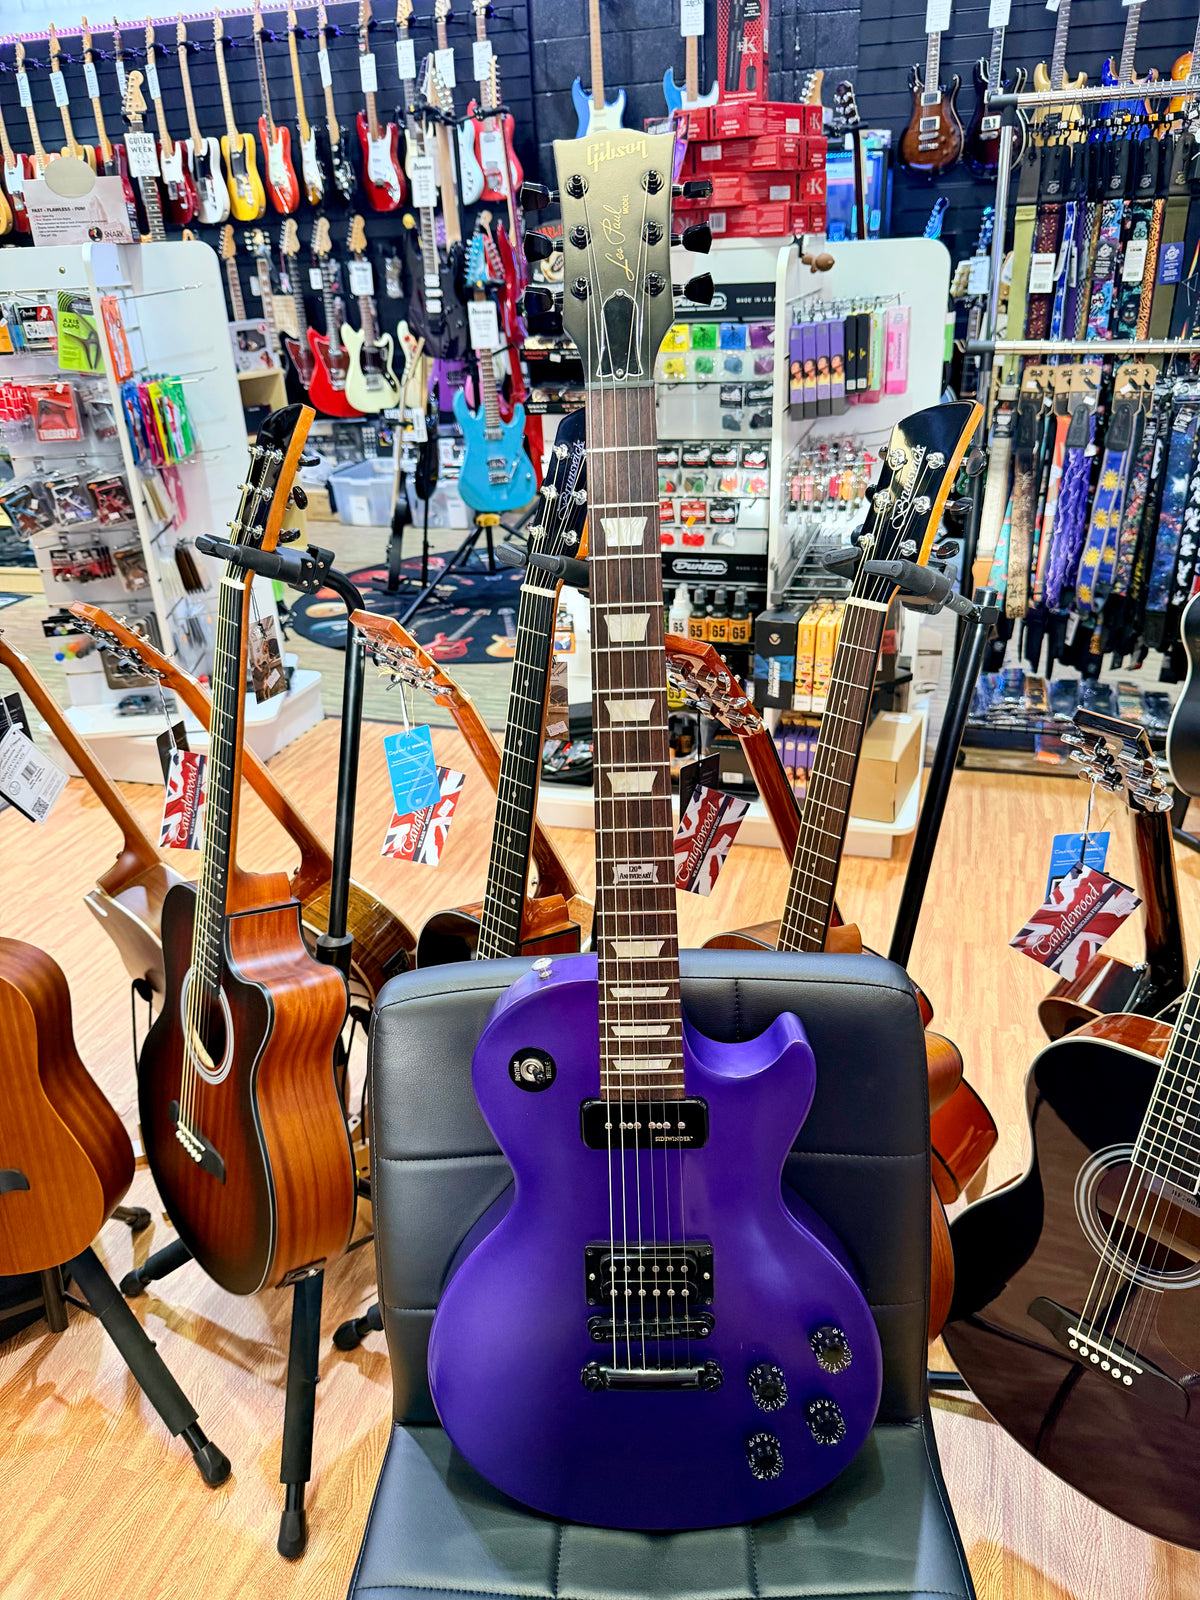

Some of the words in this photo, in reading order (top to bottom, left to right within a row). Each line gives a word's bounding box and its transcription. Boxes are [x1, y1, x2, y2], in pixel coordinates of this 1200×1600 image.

[586, 139, 648, 173] Gibson
[600, 204, 626, 246] Paul
[604, 246, 635, 282] Les
[558, 440, 585, 520] Brunswick
[889, 444, 927, 530] Brunswick
[676, 561, 724, 572] Dunlop
[673, 622, 684, 632] 65
[690, 625, 702, 638] 65
[712, 625, 726, 638] 65
[732, 626, 746, 640] 65
[176, 762, 198, 845] Tanglewood
[676, 802, 718, 884] Tanglewood
[1032, 882, 1100, 956] Tanglewood
[1054, 946, 1061, 955] WE
[1060, 938, 1070, 948] ARE
[1072, 913, 1093, 935] MUSICIANS
